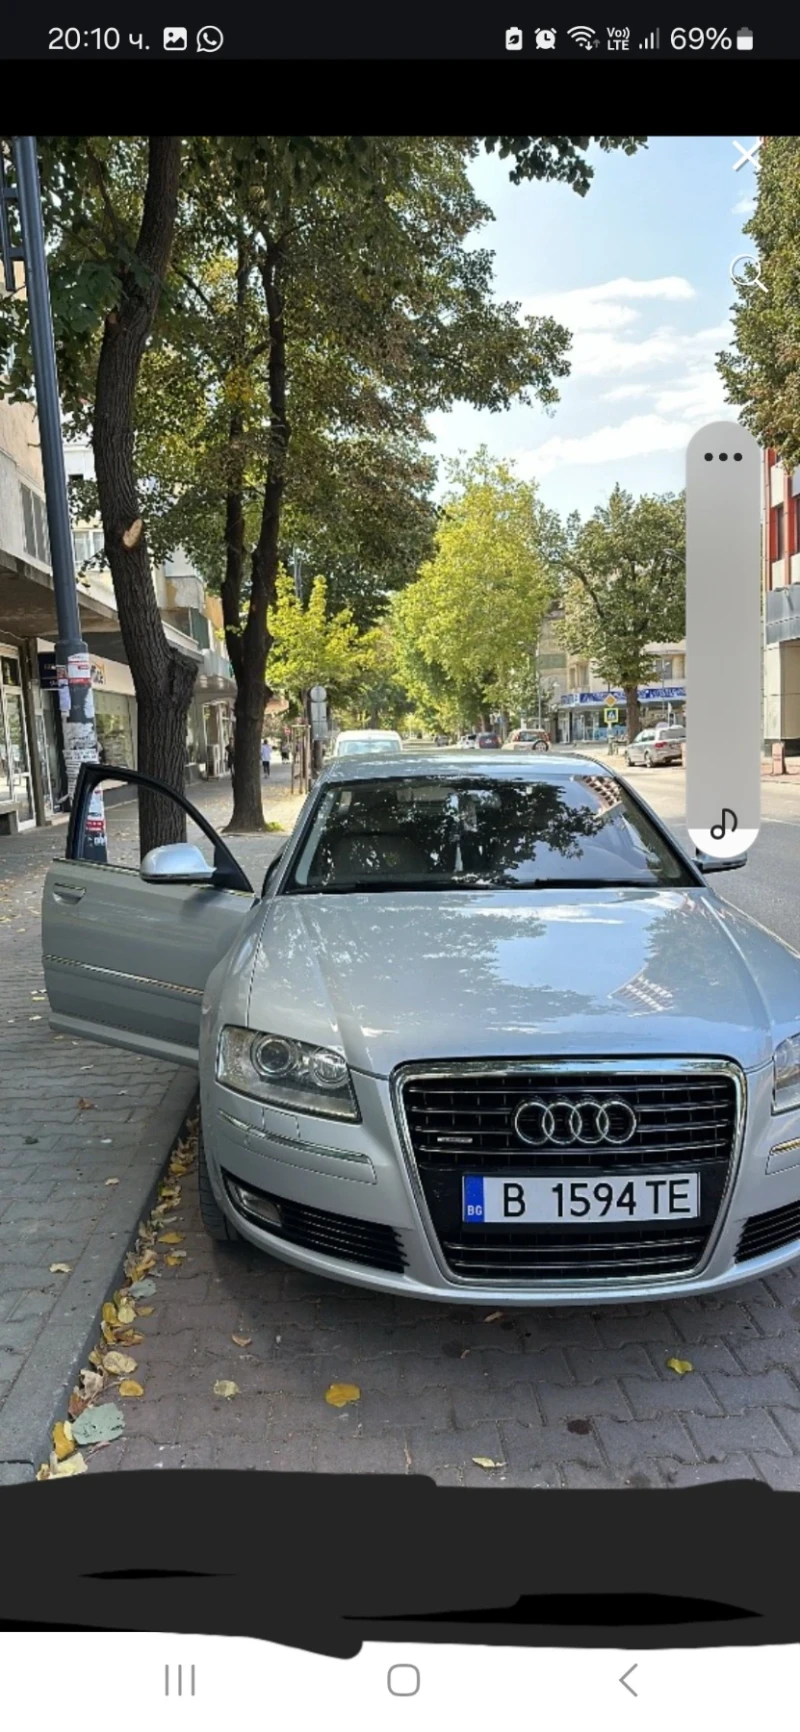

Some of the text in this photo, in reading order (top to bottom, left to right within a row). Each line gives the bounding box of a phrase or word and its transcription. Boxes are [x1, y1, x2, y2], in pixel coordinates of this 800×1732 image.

[467, 1205, 483, 1216] BG
[503, 1179, 691, 1218] B 1594 TE
